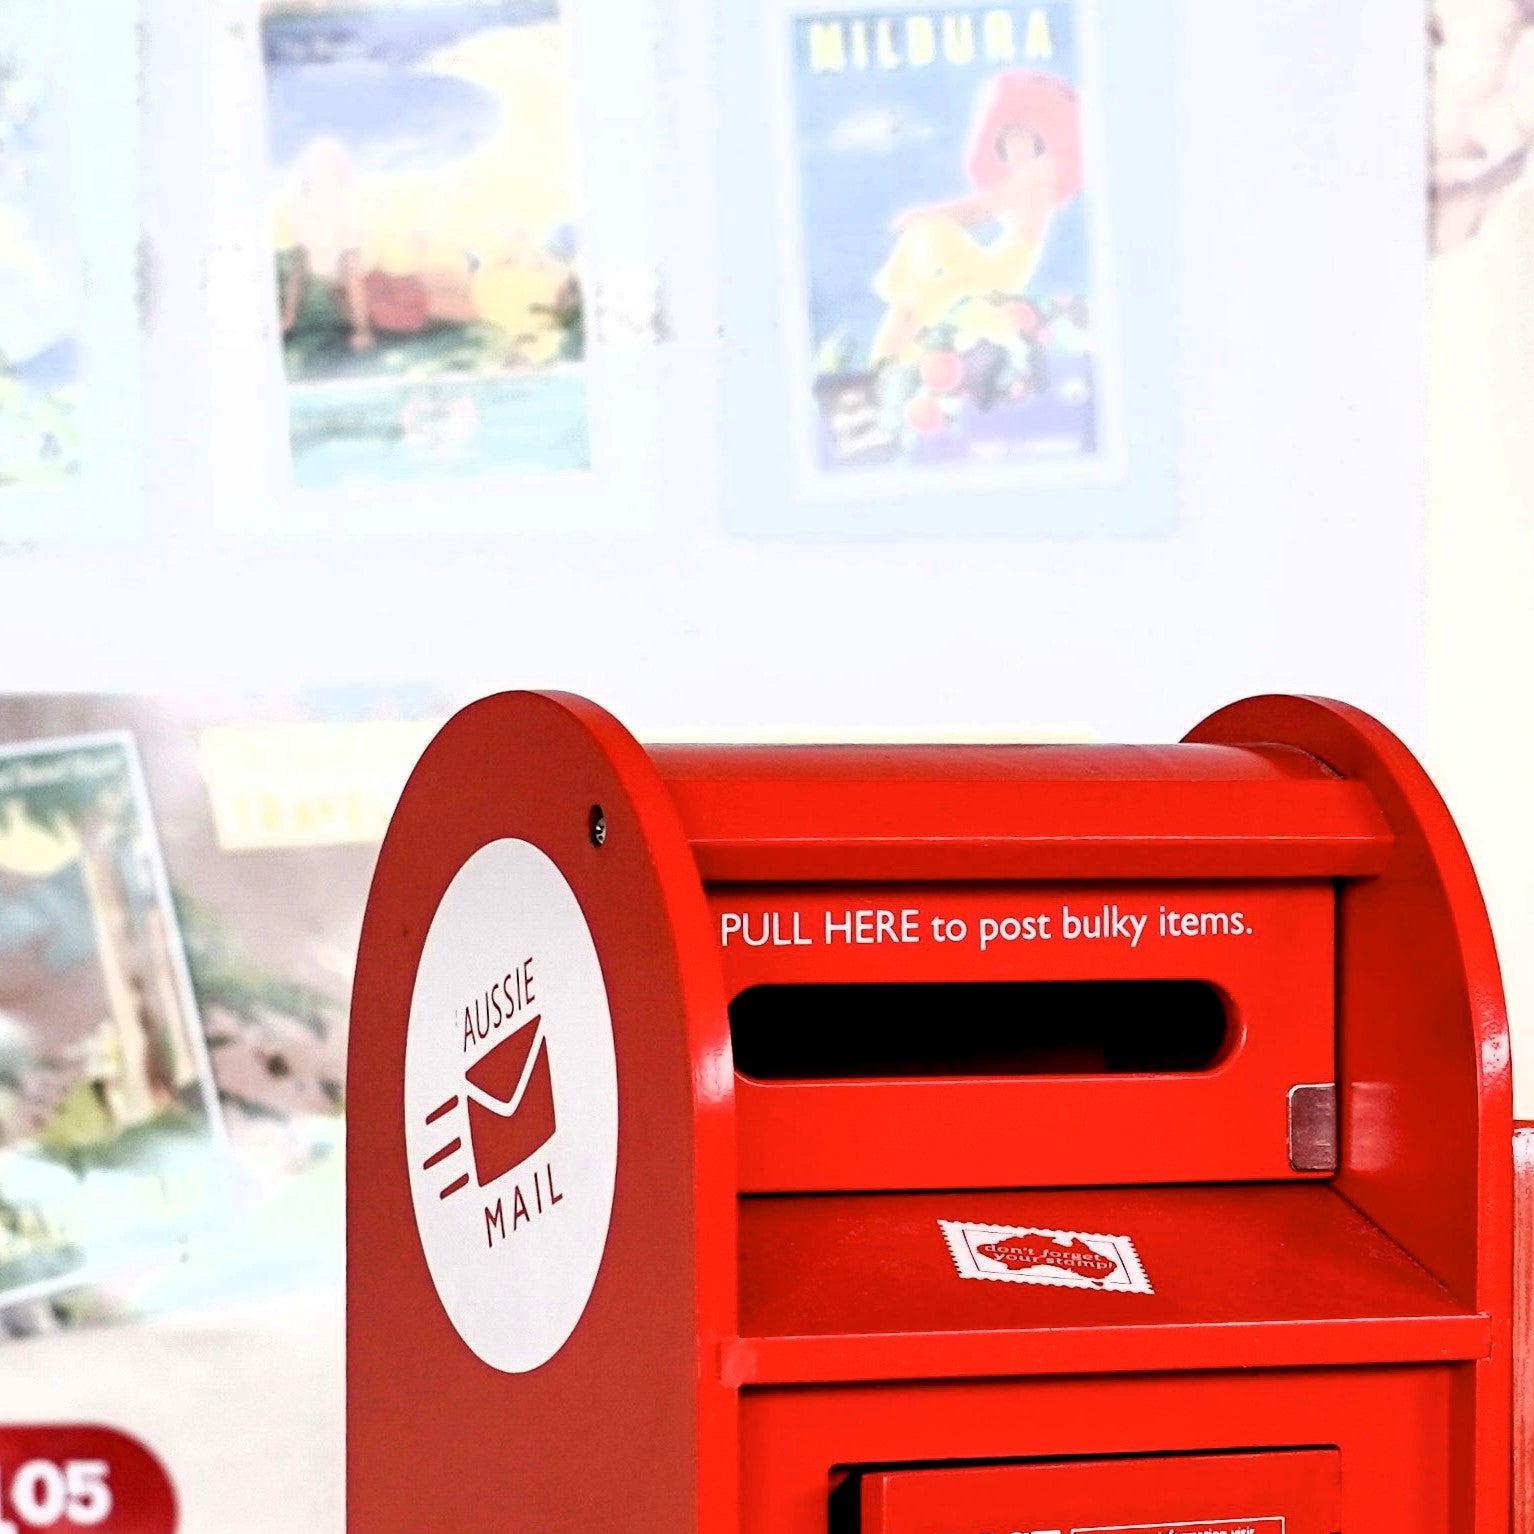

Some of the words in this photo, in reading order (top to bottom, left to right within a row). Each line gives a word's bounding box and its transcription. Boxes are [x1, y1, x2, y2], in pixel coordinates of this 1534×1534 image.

[809, 12, 1056, 70] MILDURA
[721, 913, 812, 946] PULL
[826, 909, 920, 944] HERE
[932, 915, 967, 942] to
[980, 914, 1052, 950] post
[1062, 906, 1147, 946] bulky
[1158, 906, 1253, 938] items.
[463, 957, 536, 1052] AUSSIE
[484, 1162, 564, 1248] MAIL
[984, 1244, 1035, 1256] don't
[1039, 1248, 1103, 1262] forget
[993, 1253, 1040, 1263] your
